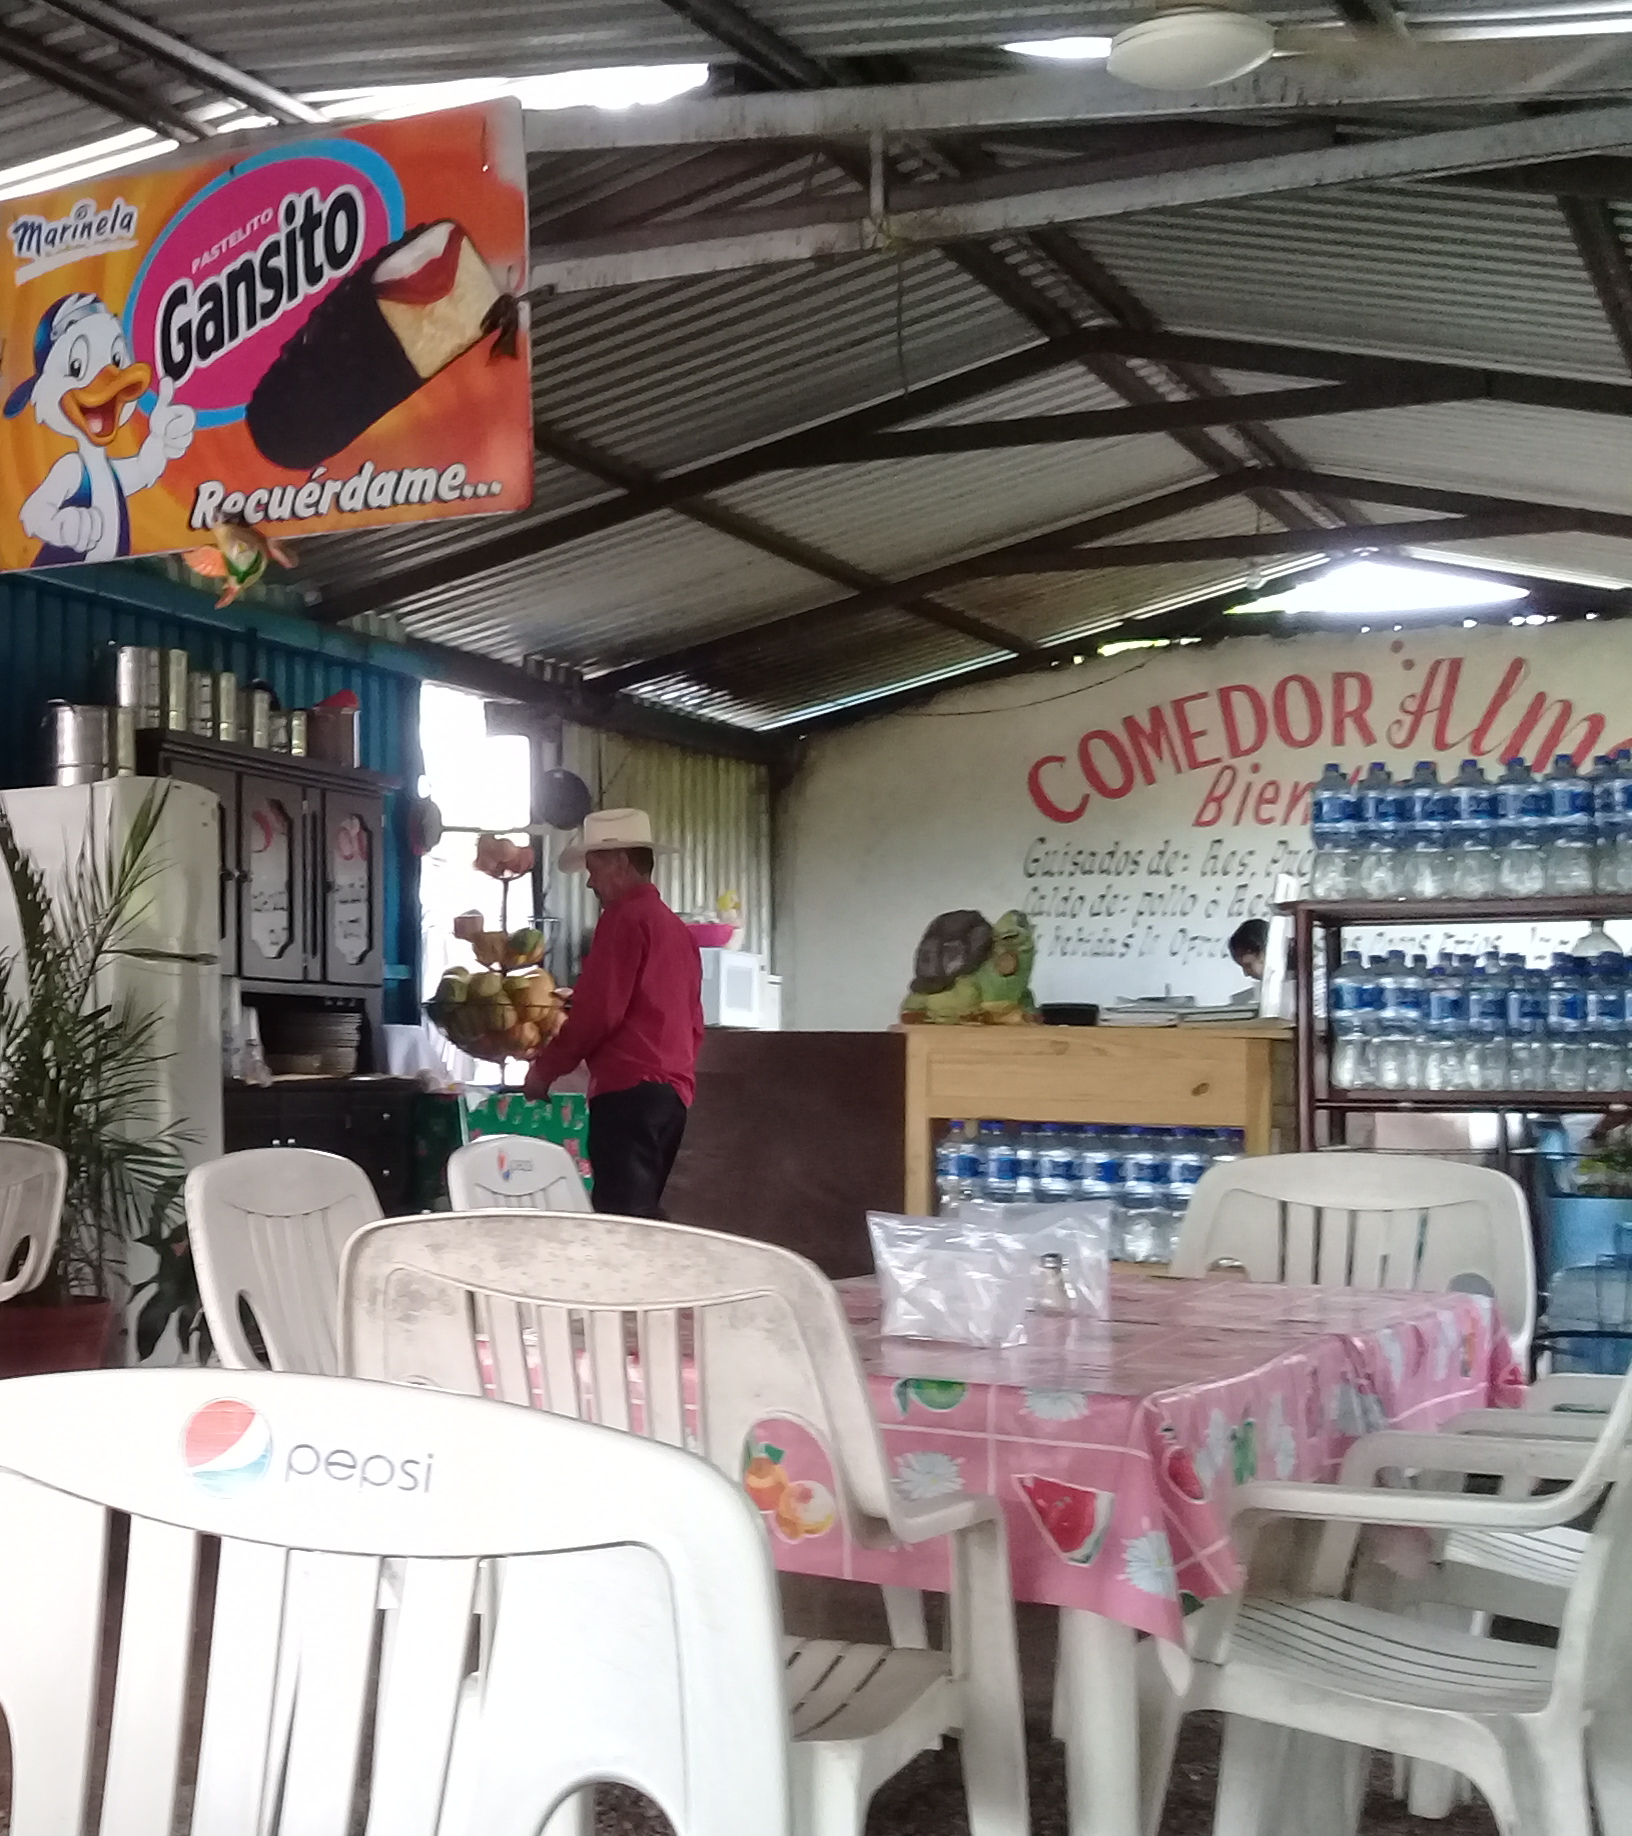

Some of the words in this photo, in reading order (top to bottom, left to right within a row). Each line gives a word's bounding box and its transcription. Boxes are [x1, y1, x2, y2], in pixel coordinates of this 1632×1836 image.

[12, 203, 135, 256] Marinela
[190, 207, 274, 275] PASTELITO
[159, 190, 361, 379] Gansito
[1027, 671, 1378, 824] COMEDOR
[1386, 657, 1632, 774] Alm
[1023, 836, 1144, 878] Guisados
[285, 1442, 435, 1494] pepsi
